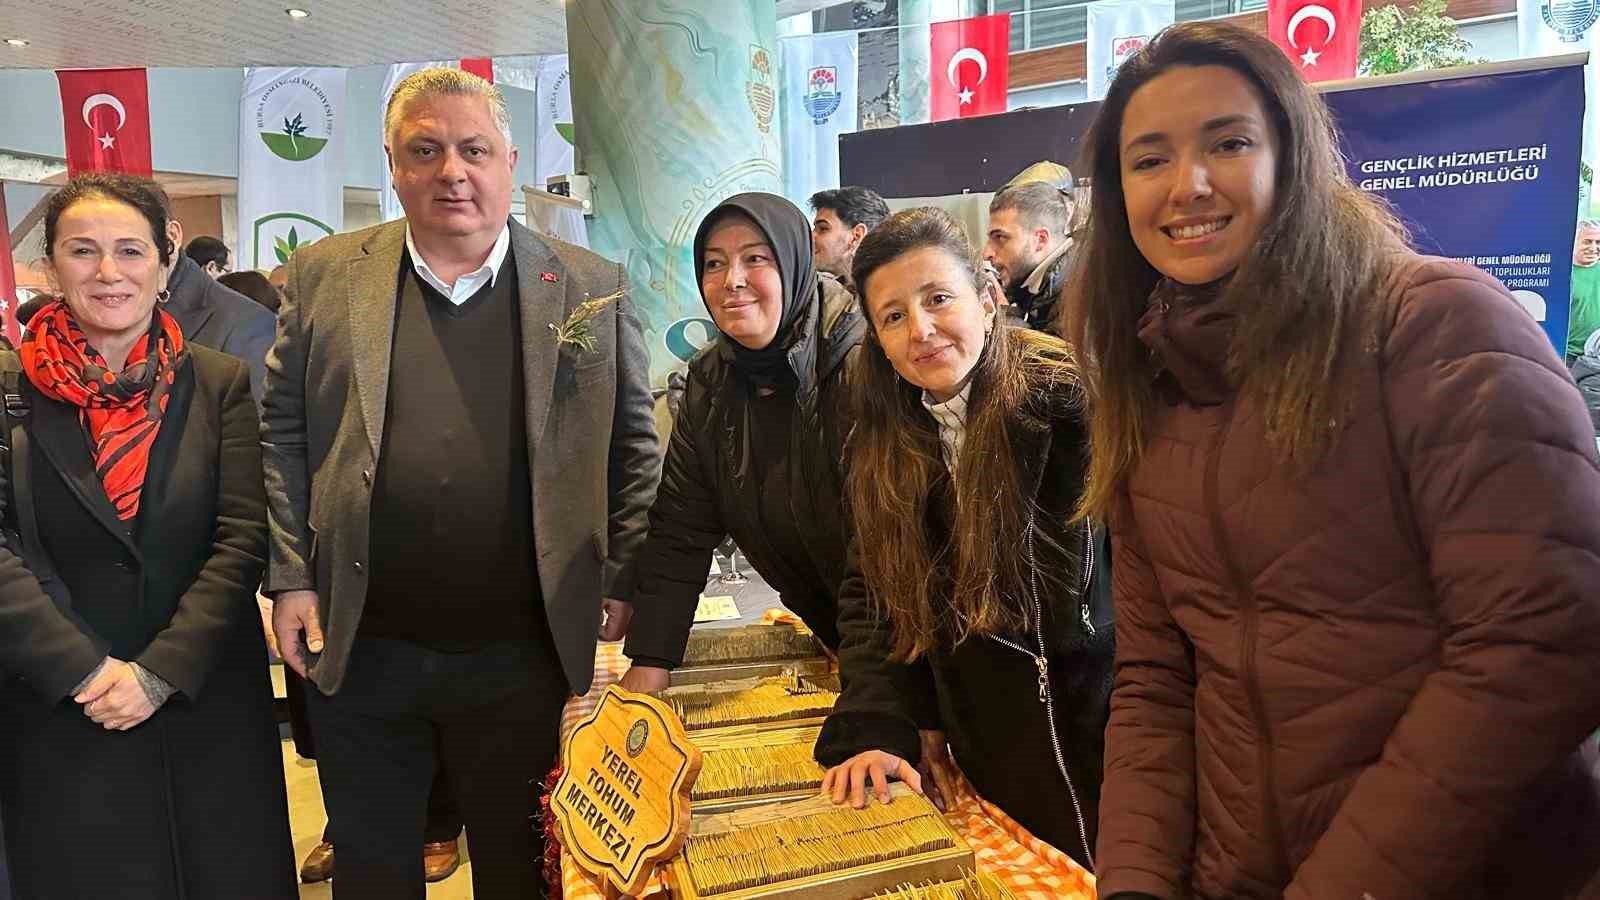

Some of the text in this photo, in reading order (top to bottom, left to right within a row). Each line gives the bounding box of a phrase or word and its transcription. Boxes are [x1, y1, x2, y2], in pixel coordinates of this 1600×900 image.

[1361, 144, 1547, 173] GENÇLİK HİZMETLERİ
[1360, 164, 1539, 191] GENEL MÜDÜRLÜĞÜ
[1477, 256, 1500, 265] GENEL
[1501, 253, 1551, 264] MÜDÜRLÜĞÜ
[1495, 266, 1550, 276] TOPLULUKLARI
[1507, 278, 1549, 288] PROGRAMI
[600, 745, 643, 798] YEREL
[586, 768, 636, 825] TOHUM
[566, 783, 636, 862] MERKEZİ
